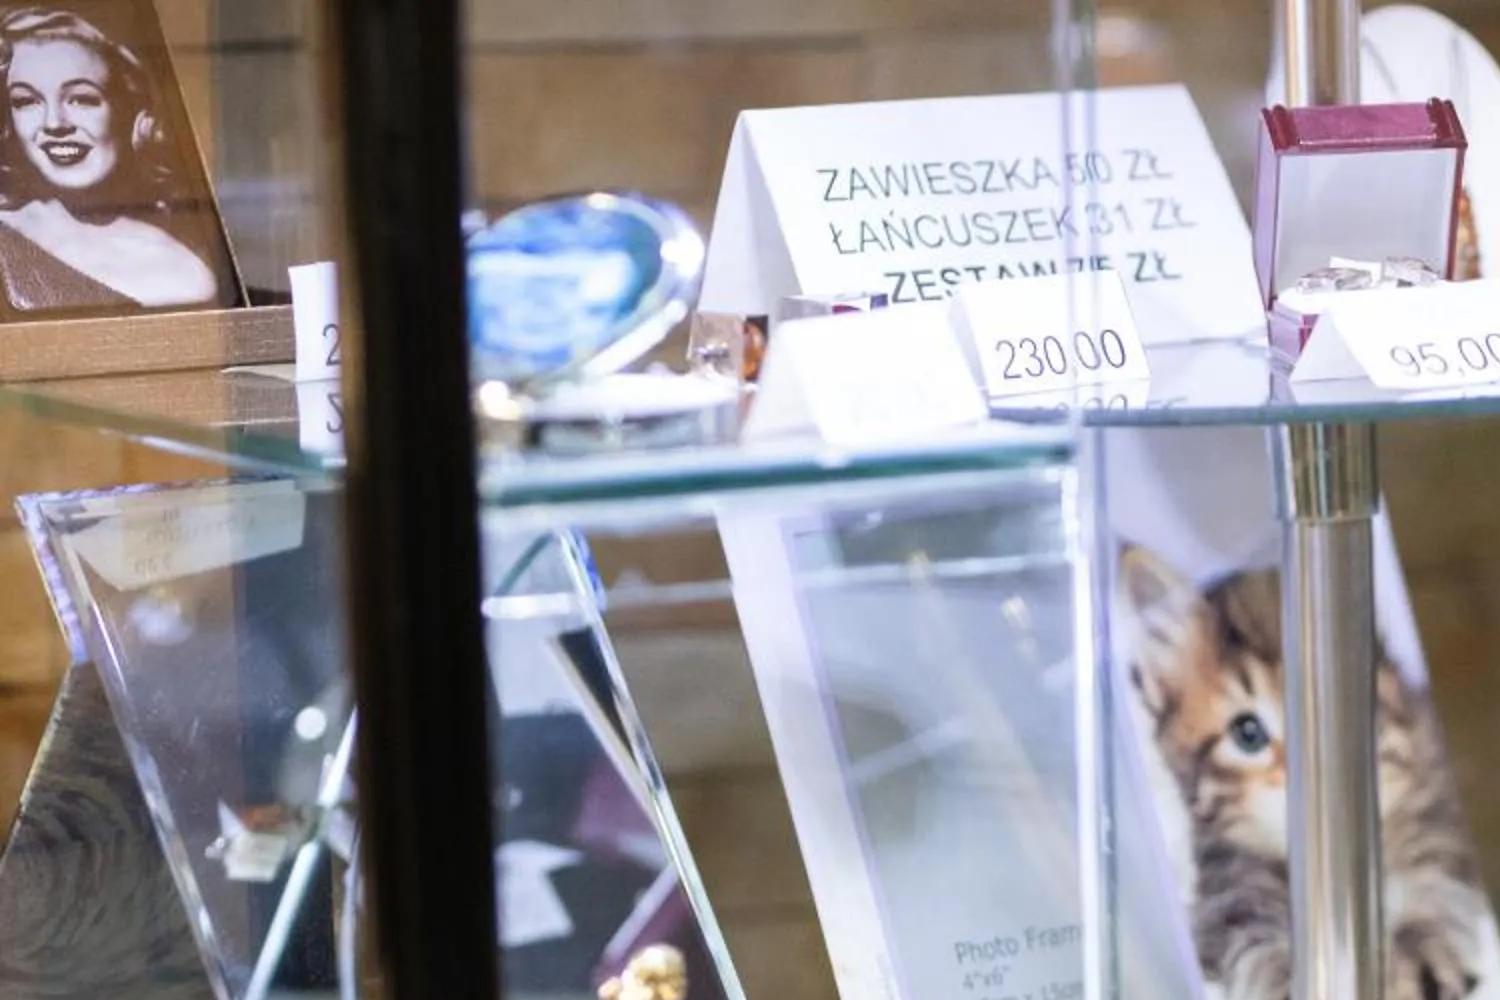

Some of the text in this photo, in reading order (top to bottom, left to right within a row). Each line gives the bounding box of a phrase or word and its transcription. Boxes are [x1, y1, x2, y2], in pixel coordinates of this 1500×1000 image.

[817, 155, 1060, 203] ZAWIESZKA
[1121, 148, 1175, 182] ZŁ
[830, 196, 1199, 256] ŁAŃCUSZEK 31 ZŁ
[1128, 250, 1183, 284] ZŁ
[954, 924, 1082, 965] Photo Fram
